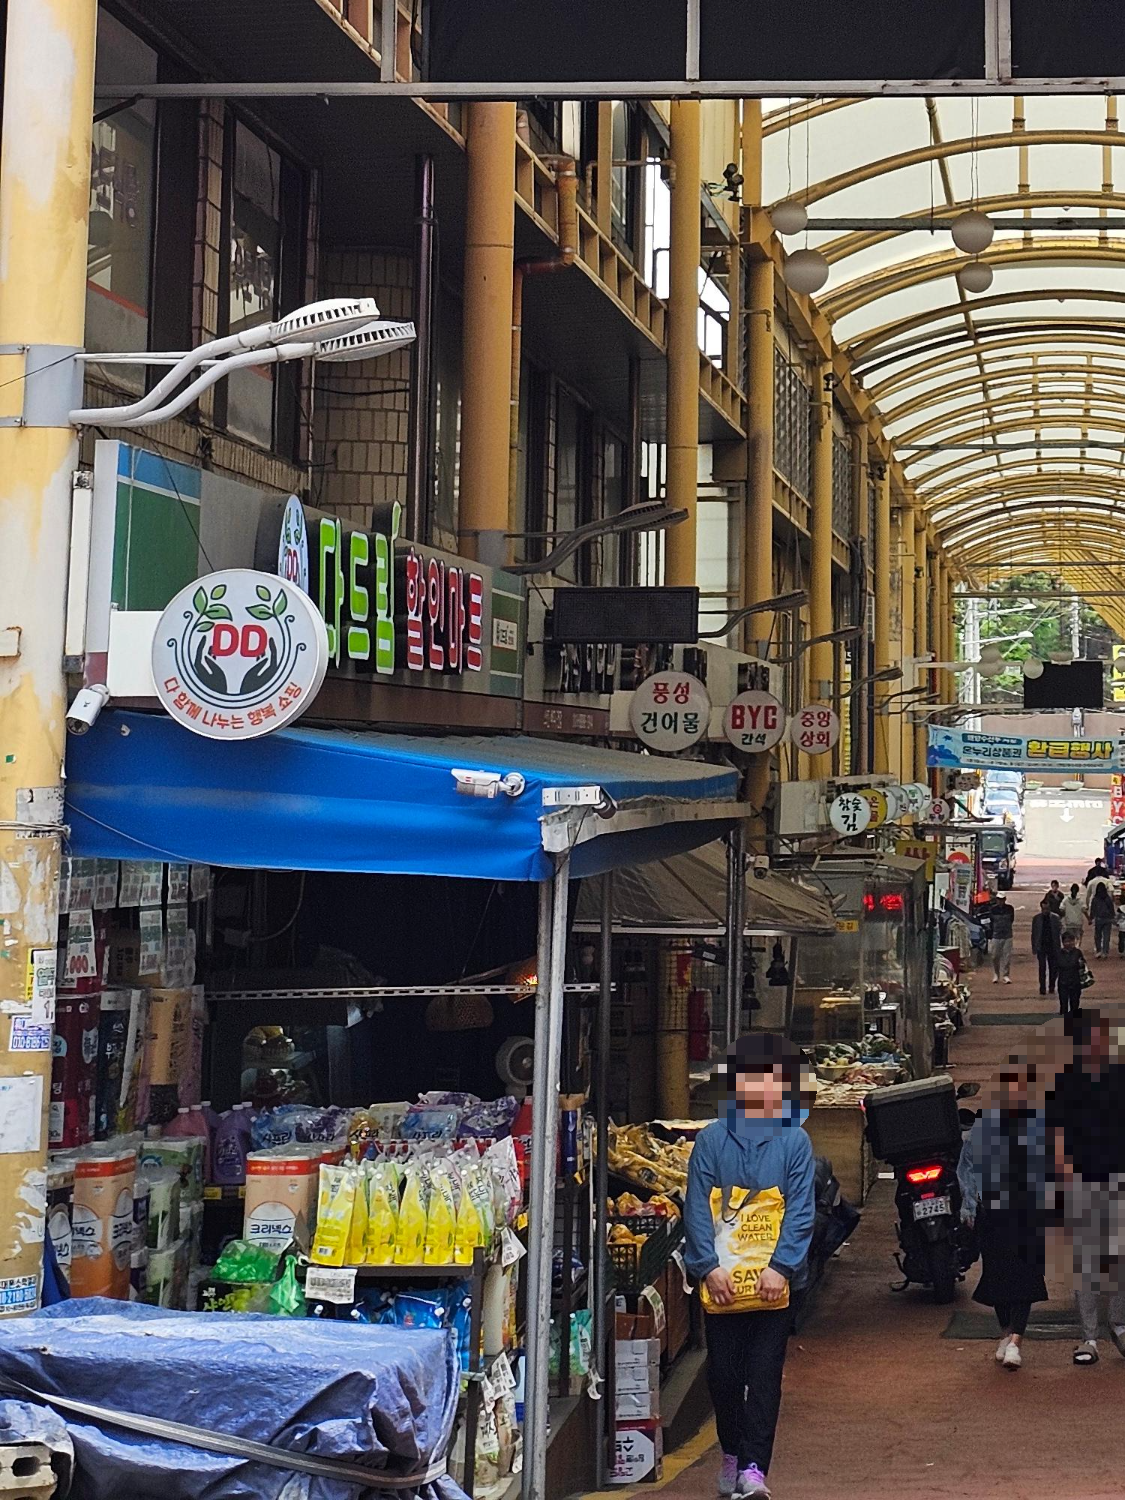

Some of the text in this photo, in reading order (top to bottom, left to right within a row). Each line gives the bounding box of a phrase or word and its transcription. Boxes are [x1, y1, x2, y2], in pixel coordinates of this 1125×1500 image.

[319, 500, 483, 676] 다드림 할인마트
[212, 623, 269, 659] DD
[652, 681, 691, 704] 풍성
[201, 709, 245, 730] 나누는
[246, 703, 278, 726] 행복
[277, 681, 303, 711] 쇼핑
[640, 711, 700, 735] 건어물
[731, 705, 778, 730] BYC
[801, 710, 832, 728] 중앙
[741, 732, 767, 746] 간석
[800, 730, 831, 748] 상회
[1026, 739, 1114, 760] 환급행사
[841, 814, 859, 833] 김
[740, 1223, 773, 1232] CLEAN
[746, 1213, 771, 1223] LOVE
[249, 1223, 293, 1235] 크리넥스
[737, 1233, 776, 1242] WATER
